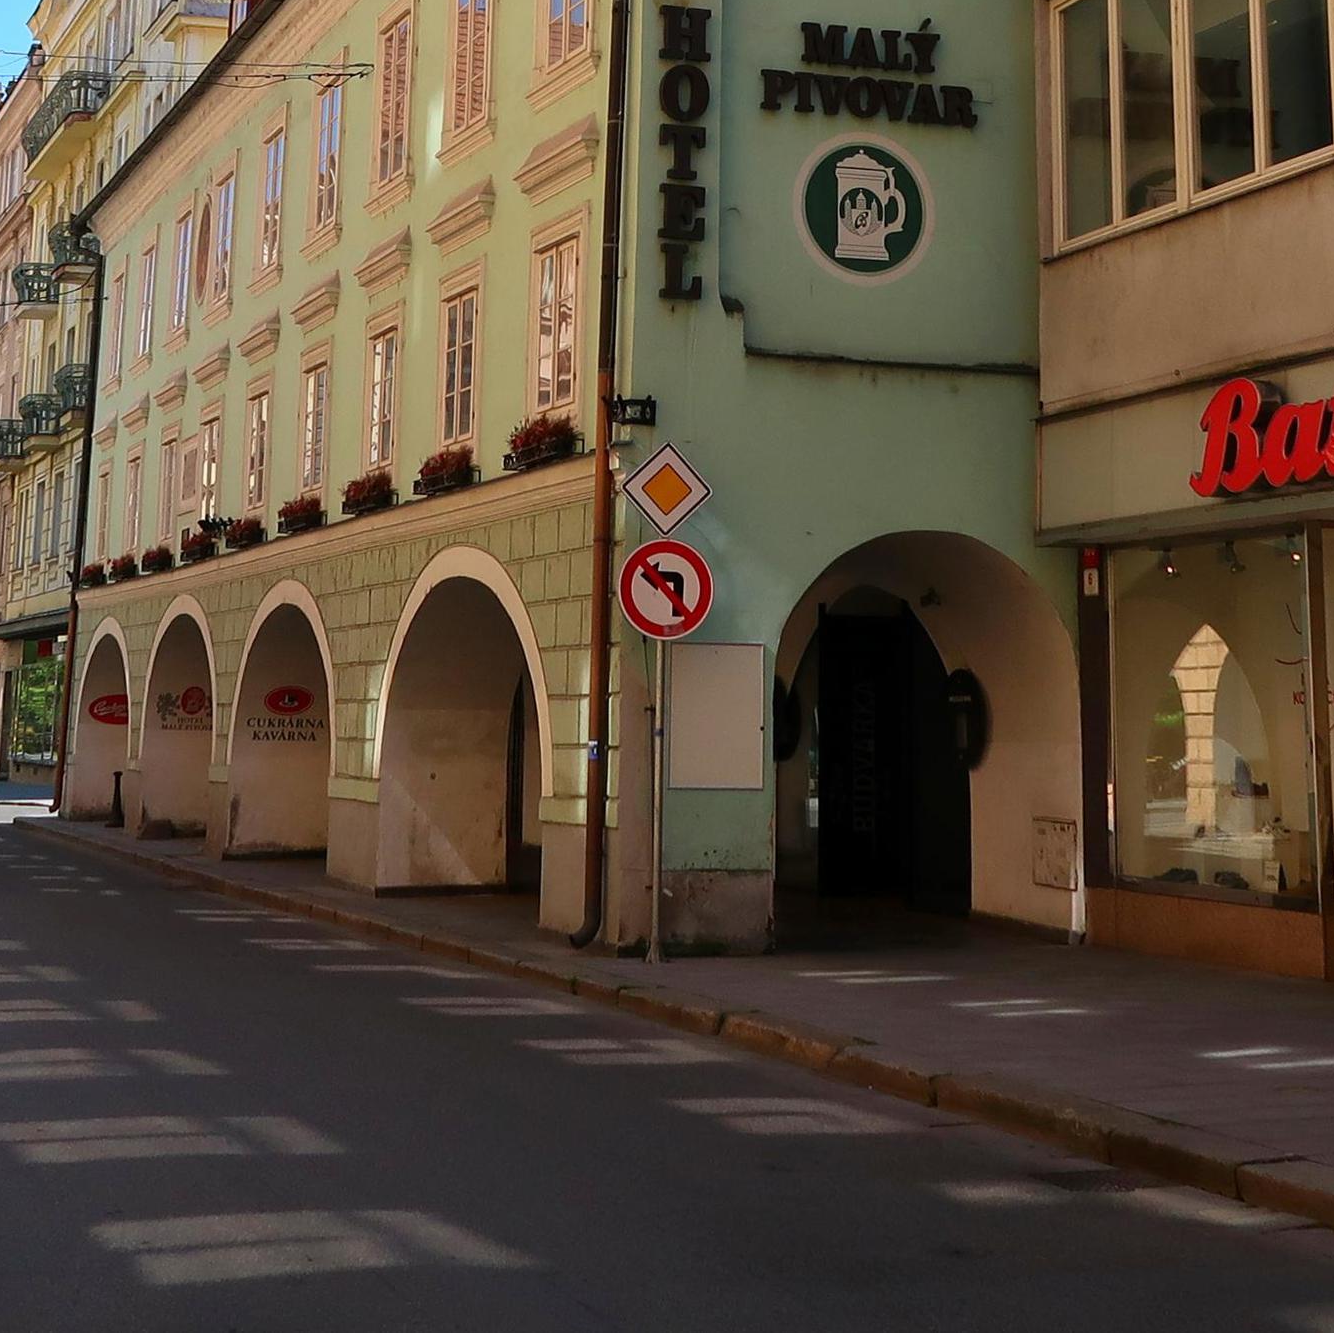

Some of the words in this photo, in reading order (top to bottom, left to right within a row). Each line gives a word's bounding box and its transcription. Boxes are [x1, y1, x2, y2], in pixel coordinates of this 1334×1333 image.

[801, 18, 941, 73] MALÝ
[759, 69, 978, 128] PIVOVAR
[659, 5, 711, 300] HOTEL
[247, 715, 324, 728] CUKRÁRNA
[252, 729, 316, 741] KAVÁRNA
